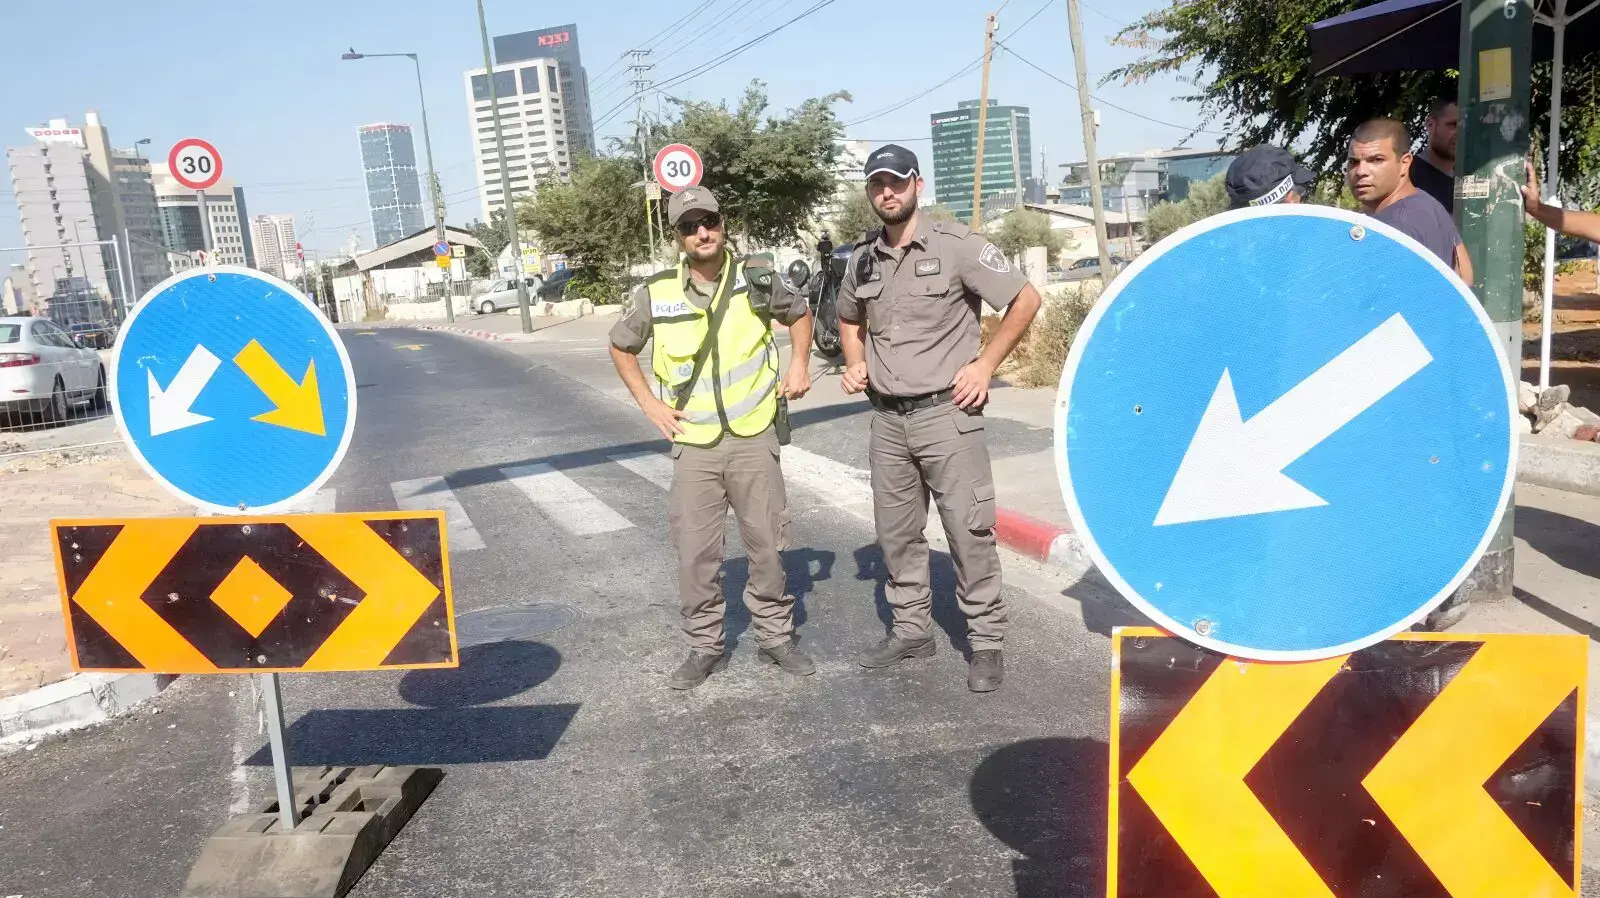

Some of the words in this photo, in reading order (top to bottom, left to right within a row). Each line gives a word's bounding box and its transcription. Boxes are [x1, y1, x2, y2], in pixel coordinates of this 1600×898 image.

[1504, 0, 1516, 19] 6
[182, 155, 211, 174] 30
[666, 159, 691, 178] 30
[655, 302, 687, 313] POLICE
